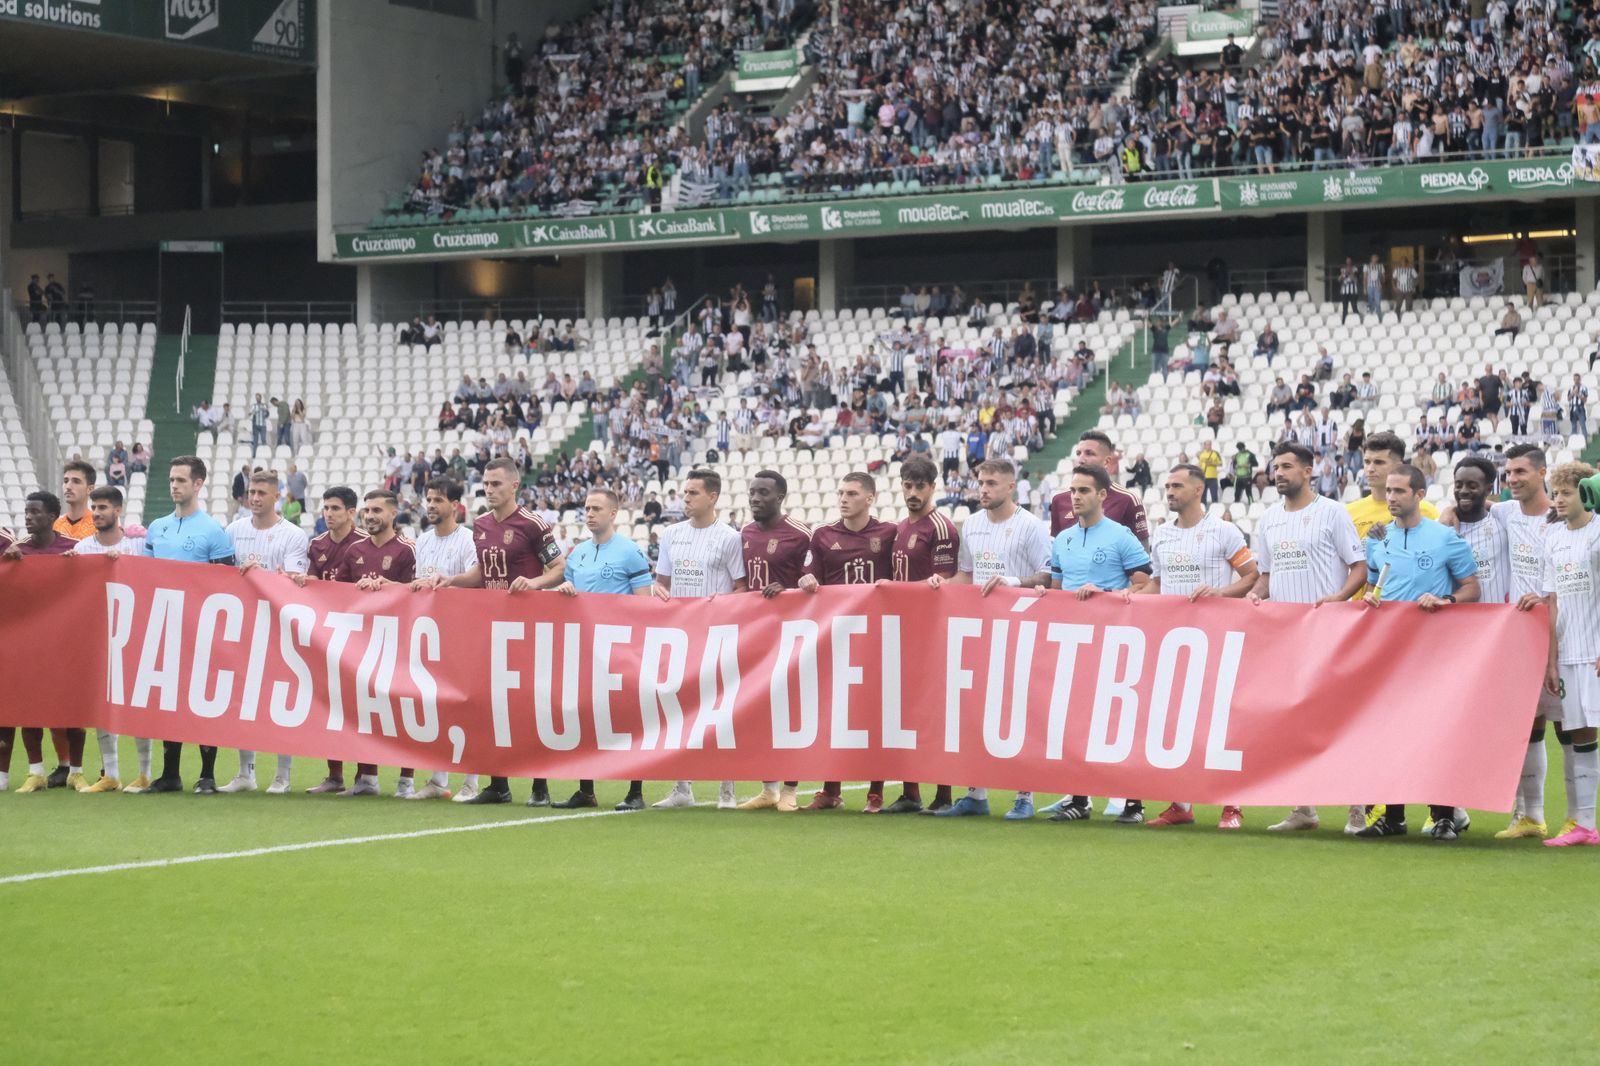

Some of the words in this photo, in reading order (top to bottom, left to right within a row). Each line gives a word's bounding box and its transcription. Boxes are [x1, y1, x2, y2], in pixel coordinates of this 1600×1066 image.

[25, 0, 101, 28] solutions
[275, 19, 297, 46] 90
[743, 57, 794, 73] Cruzcampo
[1420, 172, 1466, 188] PIEDRA
[1508, 166, 1555, 183] PIEDRA
[549, 224, 608, 241] CaixaBank
[656, 217, 716, 235] CaixaBank
[352, 237, 416, 252] Cruzcampo
[433, 232, 499, 247] Cruzcampo
[105, 582, 466, 764] RACISTAS,
[490, 620, 741, 751] FUERA
[770, 615, 917, 750] DEL
[944, 597, 1246, 772] FÚTBOL
